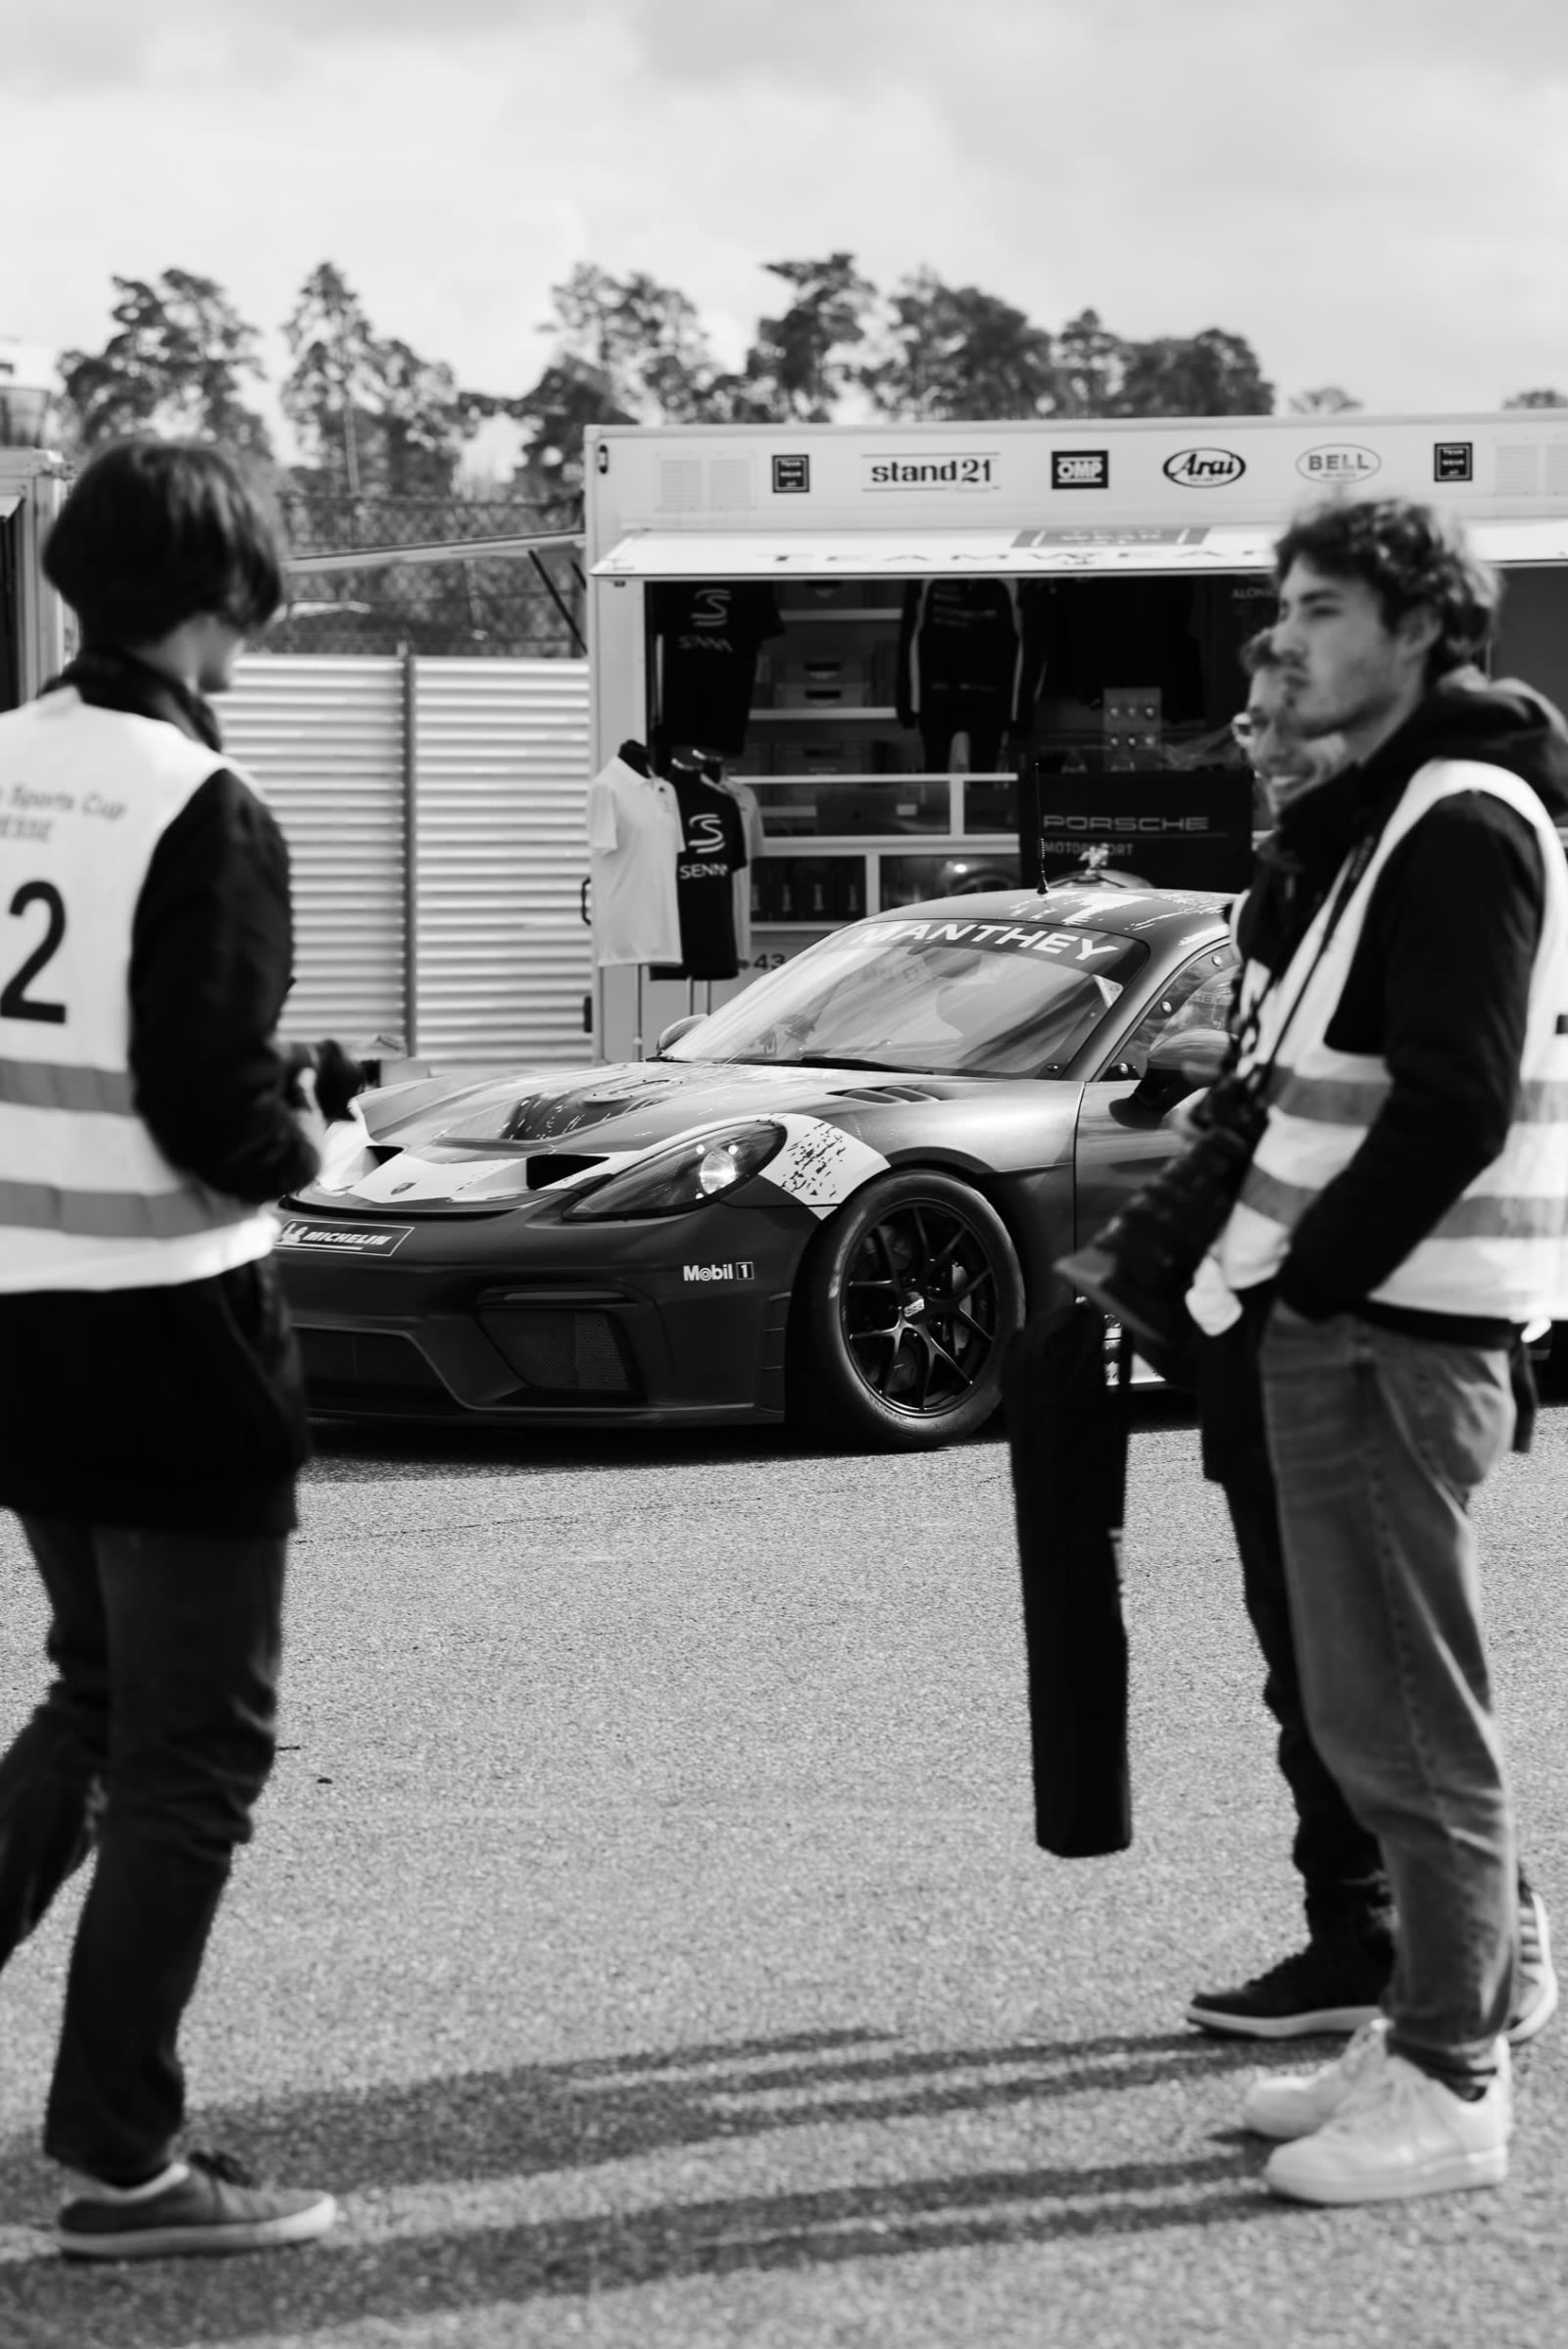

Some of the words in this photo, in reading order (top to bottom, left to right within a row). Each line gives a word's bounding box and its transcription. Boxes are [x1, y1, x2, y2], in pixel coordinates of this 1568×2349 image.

[871, 459, 991, 484] stand21
[1057, 462, 1103, 480] OMP
[1171, 454, 1236, 477] Arai
[1308, 454, 1370, 472] BELL
[1044, 815, 1209, 832] PORSCHE
[852, 924, 1119, 961] MANTHEY
[0, 880, 67, 1025] 2
[302, 1231, 393, 1246] MICHELIN
[683, 1263, 734, 1282] Mobil
